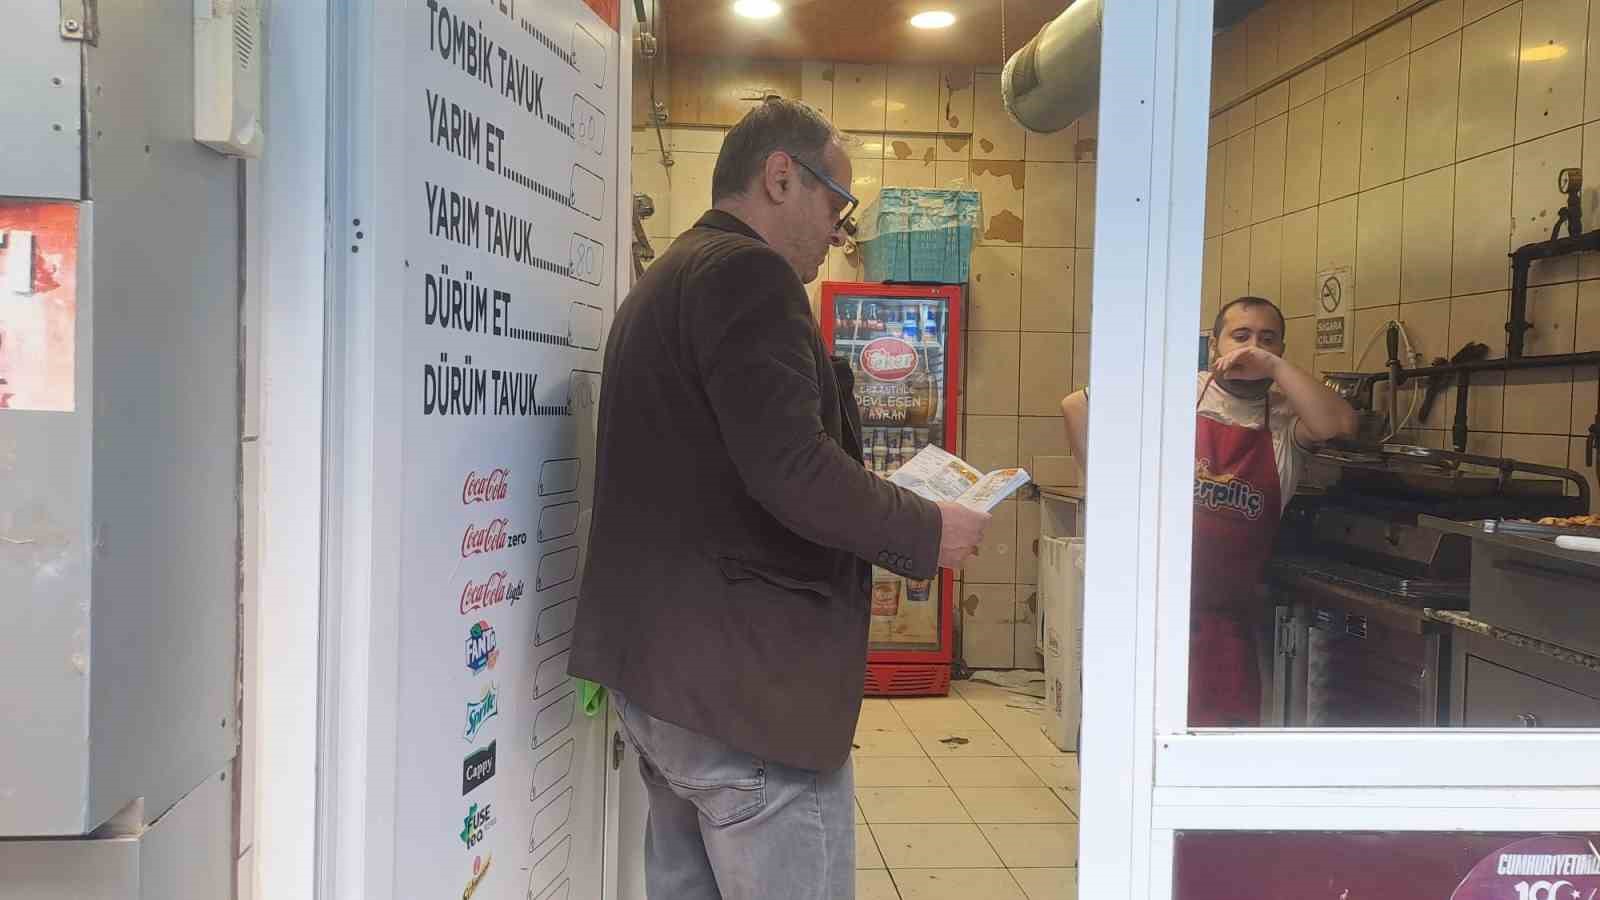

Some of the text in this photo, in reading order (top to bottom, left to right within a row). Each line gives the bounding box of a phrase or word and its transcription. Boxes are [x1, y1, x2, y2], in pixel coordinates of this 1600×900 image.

[427, 0, 543, 119] TOMBİK TAVUK
[426, 88, 504, 174] YARIM ET
[425, 181, 532, 265] YARIM TAVUK
[425, 264, 511, 337] DÜRÜM ET
[424, 353, 486, 415] DÜRÜM
[492, 370, 538, 416] TAVUK
[508, 532, 527, 547] zero
[506, 580, 524, 606] light
[466, 757, 492, 781] Cappy
[467, 804, 491, 832] FUSE
